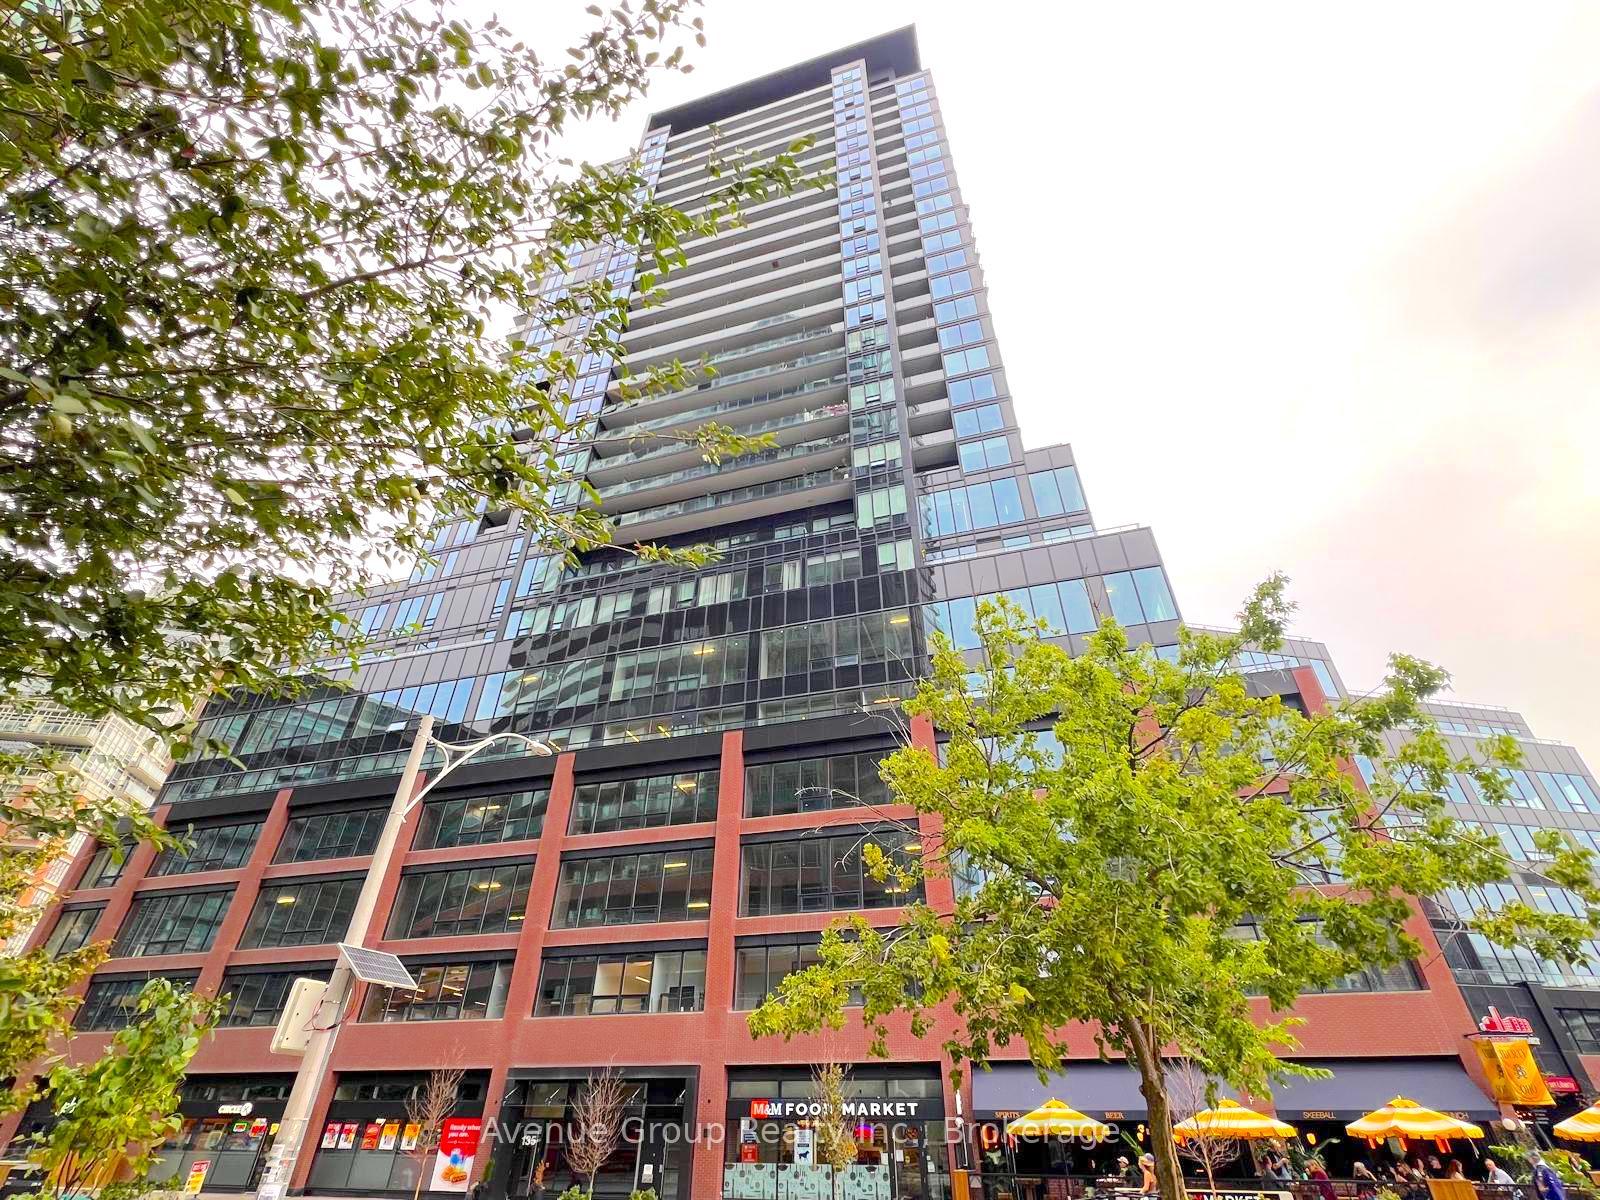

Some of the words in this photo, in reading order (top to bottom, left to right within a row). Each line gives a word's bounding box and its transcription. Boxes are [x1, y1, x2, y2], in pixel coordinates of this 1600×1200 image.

[753, 1103, 782, 1116] M&M
[842, 1103, 918, 1115] MARKET
[1303, 1111, 1336, 1119] SKEEBALL
[521, 1135, 537, 1146] 135
